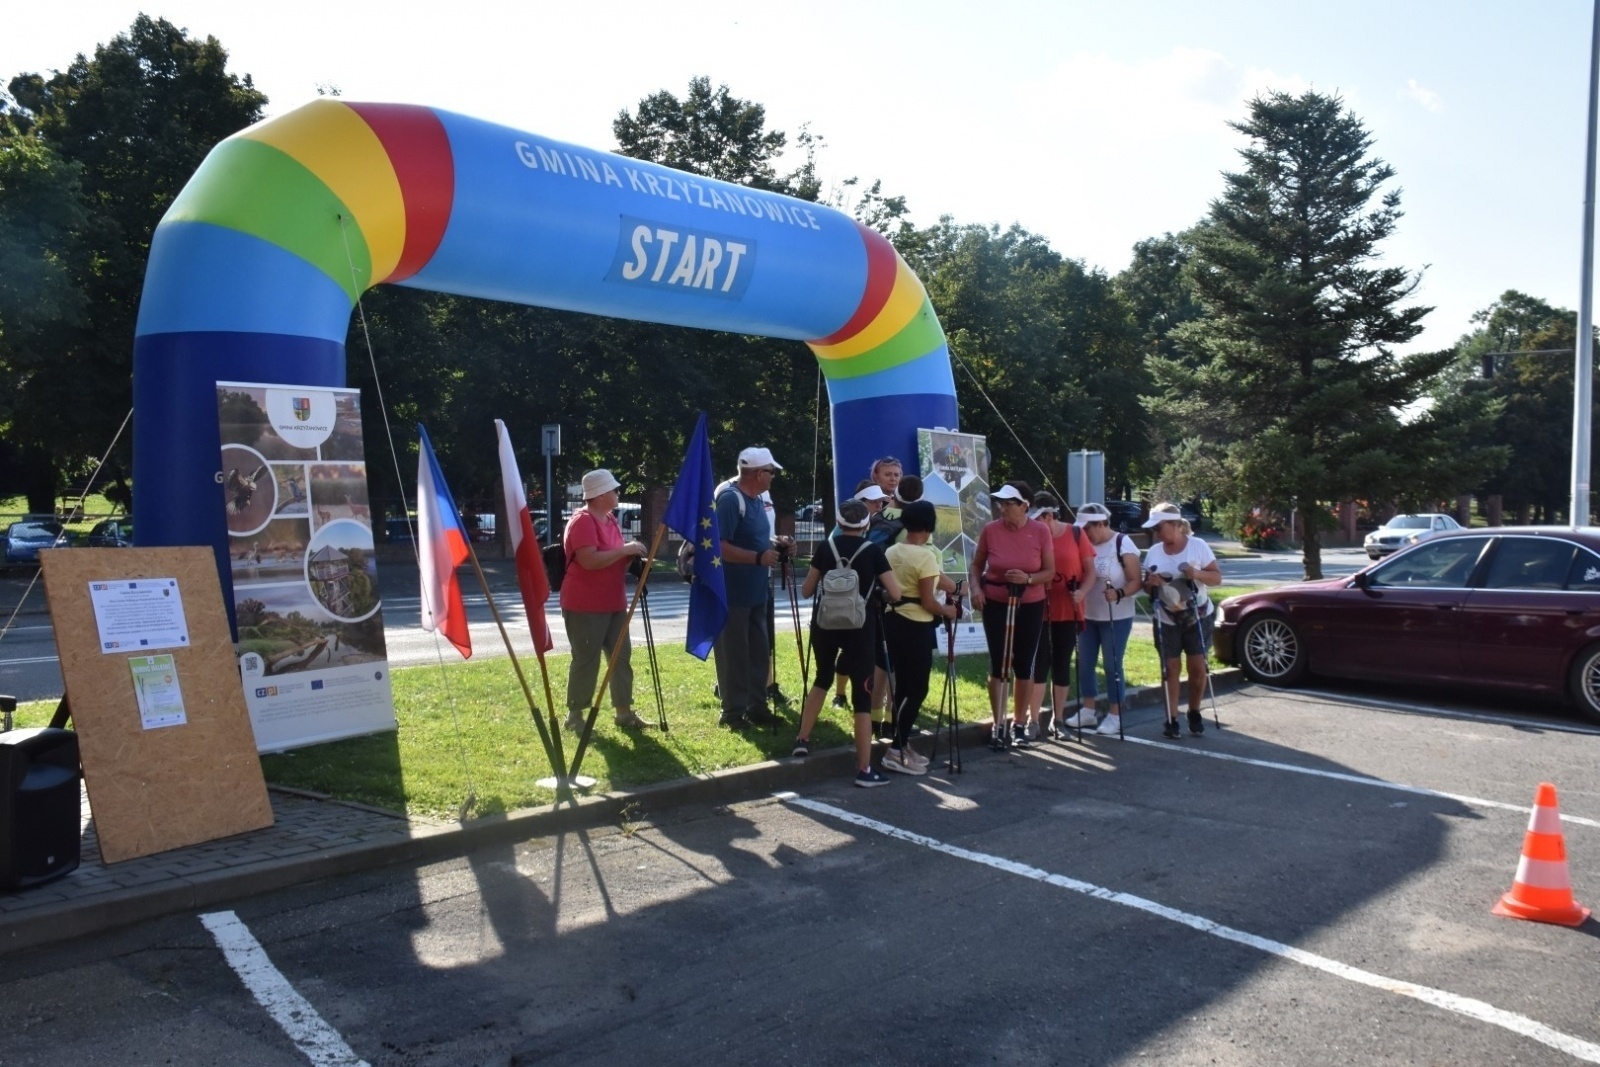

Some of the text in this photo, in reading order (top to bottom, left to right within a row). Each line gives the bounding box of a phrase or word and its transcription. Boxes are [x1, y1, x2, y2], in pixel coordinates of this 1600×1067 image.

[514, 140, 821, 231] GMINA KRZYŻANOWICE
[622, 224, 747, 293] START
